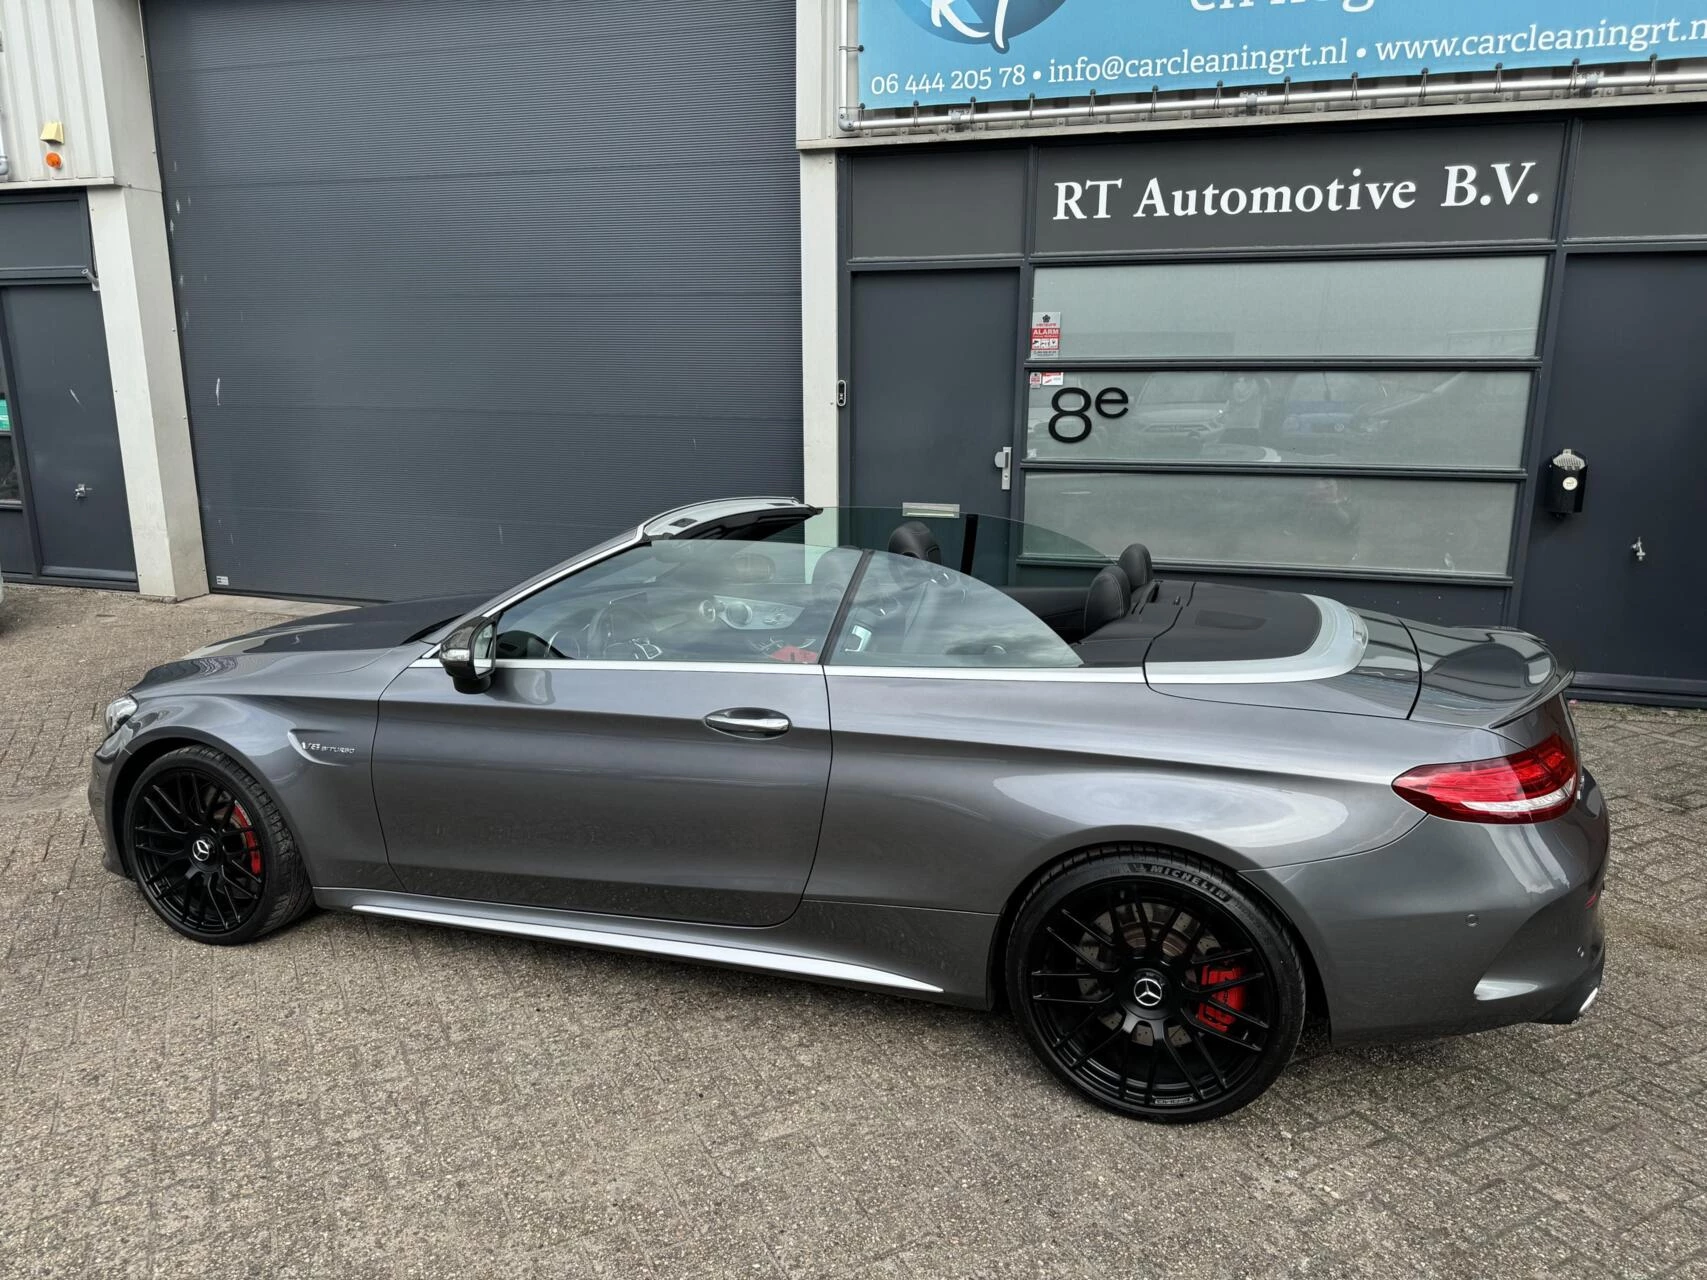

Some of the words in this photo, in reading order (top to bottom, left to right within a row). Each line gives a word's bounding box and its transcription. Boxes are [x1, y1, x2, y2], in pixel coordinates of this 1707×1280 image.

[871, 73, 899, 95] 06
[904, 72, 945, 95] 444
[951, 66, 992, 90] 205
[999, 64, 1026, 88] 78
[1047, 37, 1349, 84] info@carcleaningrt.nl
[1052, 178, 1122, 221] RT
[1132, 168, 1417, 219] Automotive
[1440, 161, 1541, 208] B.V.
[301, 741, 320, 750] V8
[1150, 864, 1227, 899] MICHELIN
